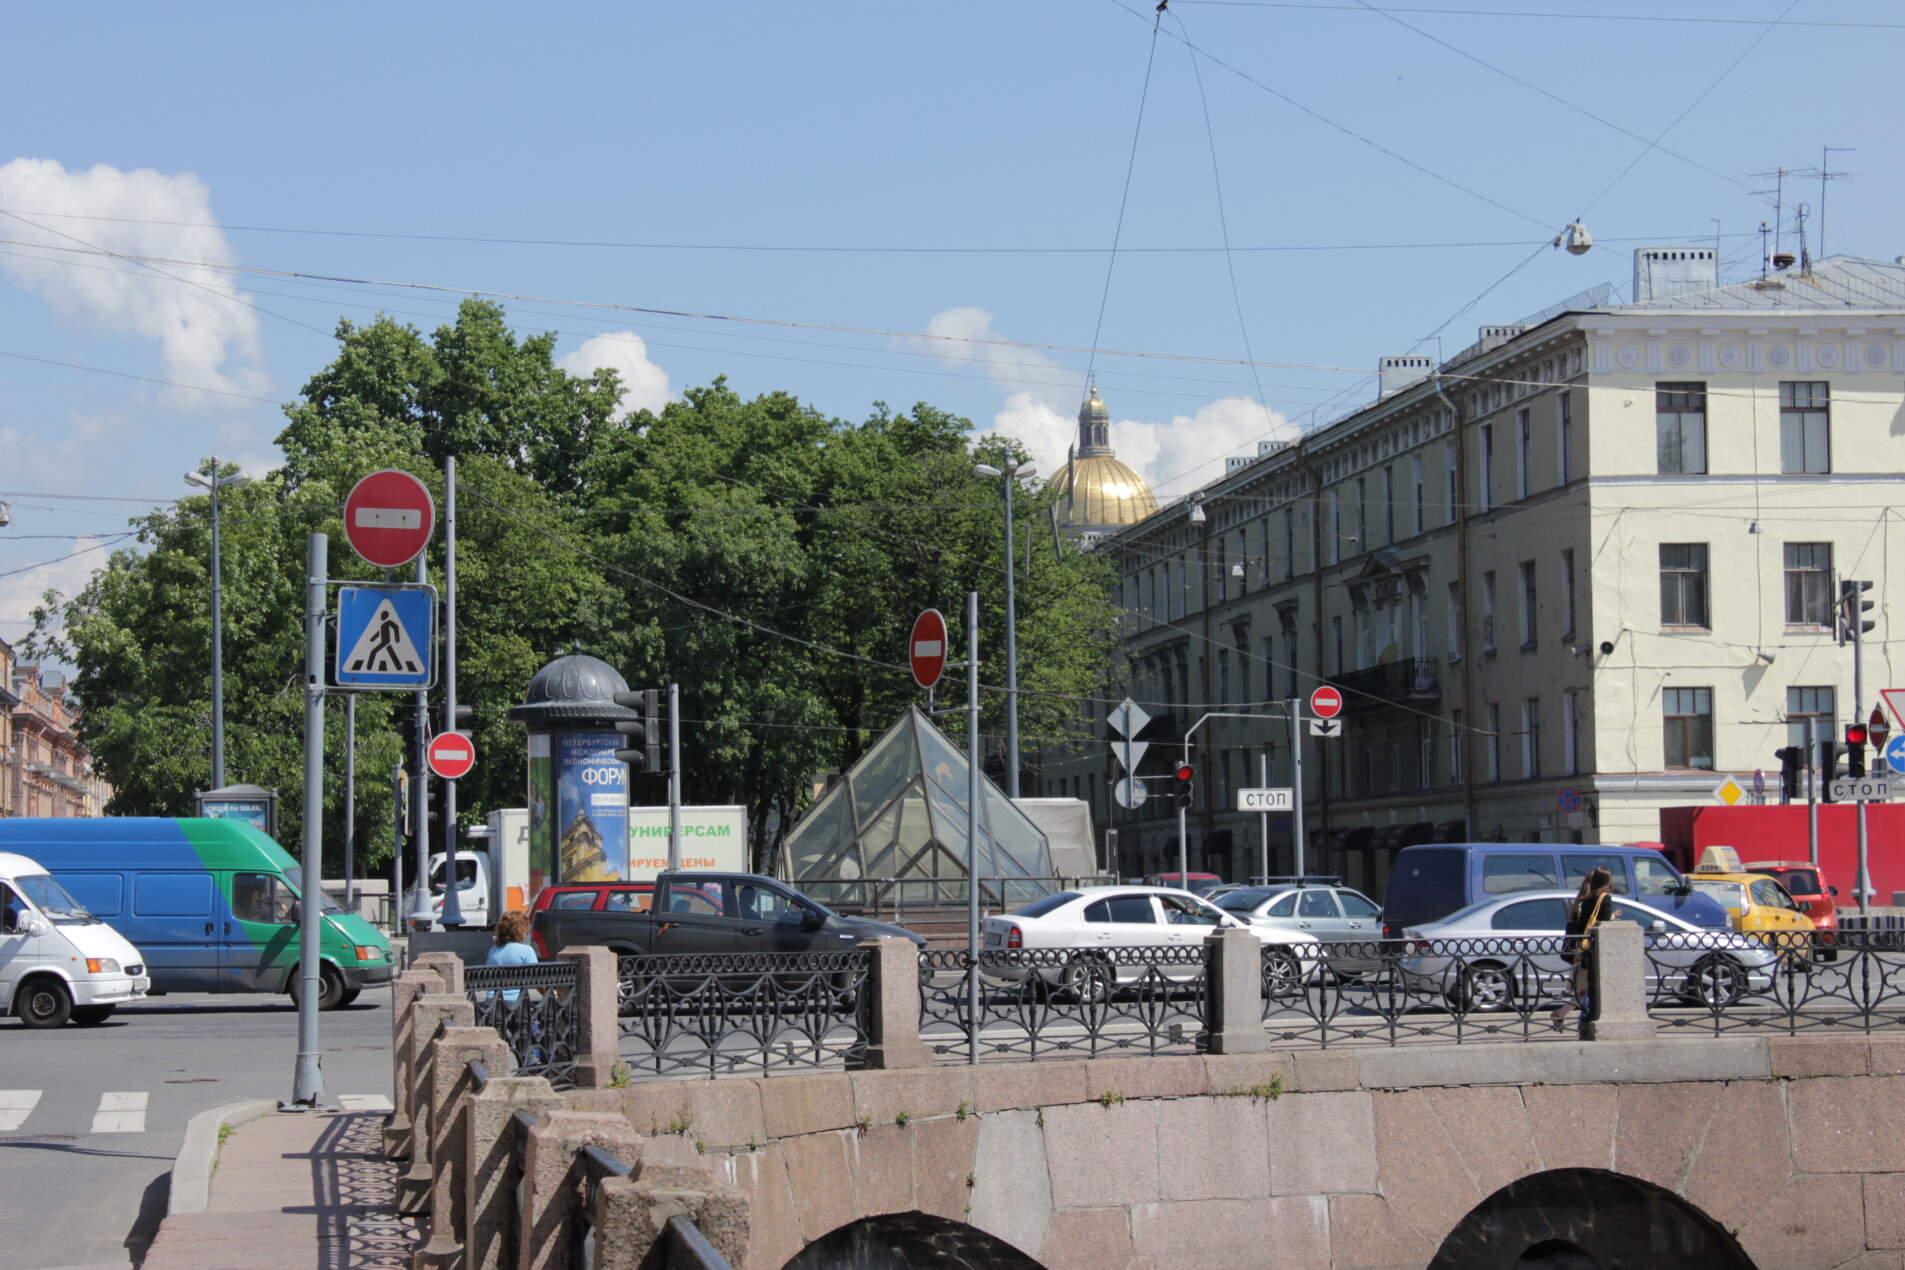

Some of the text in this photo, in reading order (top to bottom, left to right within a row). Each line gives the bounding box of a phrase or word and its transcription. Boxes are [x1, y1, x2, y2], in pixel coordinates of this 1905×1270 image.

[570, 748, 616, 757] МЕЖДУНАРО
[1834, 783, 1887, 796] СТОП
[1246, 793, 1286, 806] СТОП
[629, 857, 671, 869] ИРУЕМ
